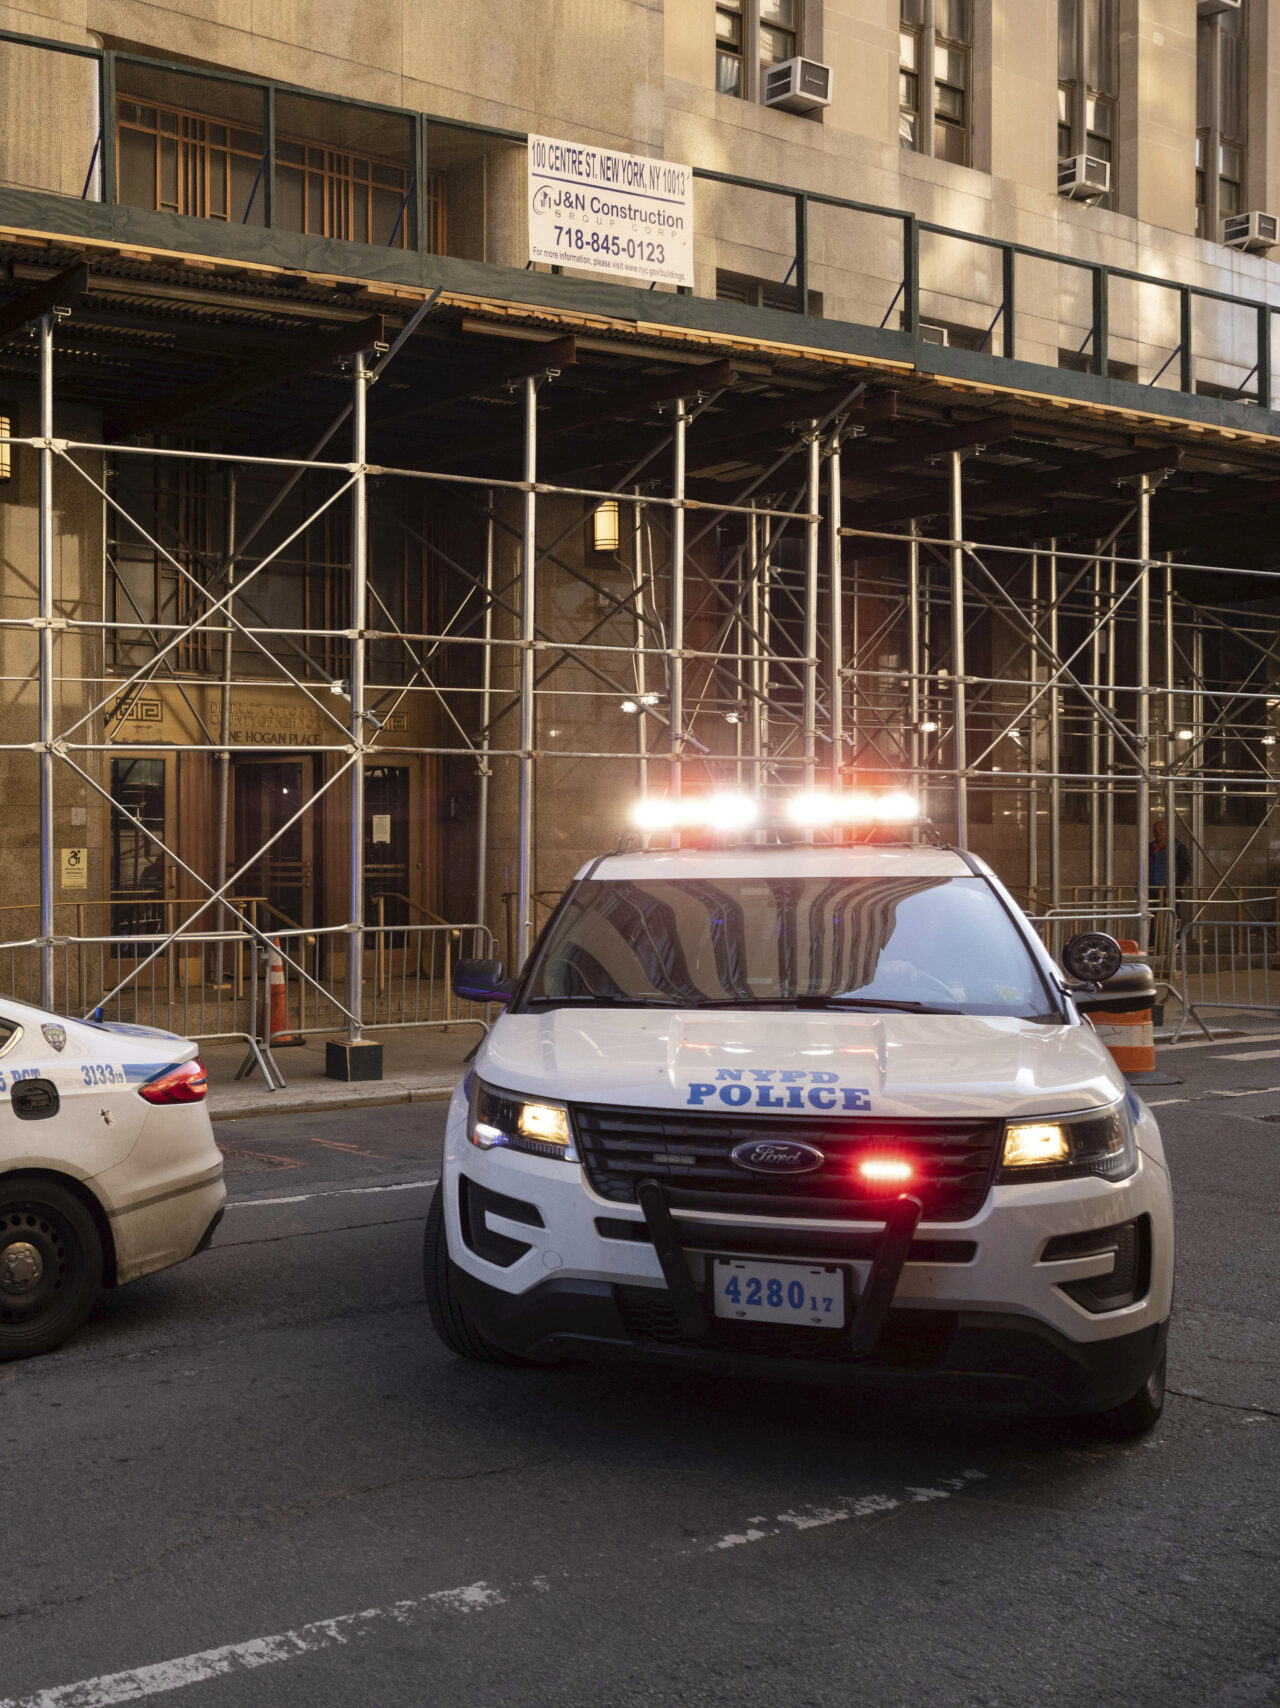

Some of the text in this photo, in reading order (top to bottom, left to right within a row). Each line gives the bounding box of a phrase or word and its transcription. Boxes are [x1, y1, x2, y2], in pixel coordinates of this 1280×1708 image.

[532, 141, 685, 196] 100 CENTRE ST. NEW YORK, NY 10013
[553, 190, 684, 230] J&N Construction
[554, 209, 677, 239] GROUP CORP
[532, 246, 543, 256] For
[544, 249, 558, 259] more
[593, 257, 611, 269] please
[612, 260, 624, 271] visit
[554, 225, 665, 264] 718-845-0123
[219, 730, 321, 745] NE HOGAN PLACE
[714, 1068, 840, 1084] NYPD
[686, 1083, 872, 1111] POLICE
[751, 1144, 802, 1164] Ford
[724, 1275, 833, 1312] 4280 17
